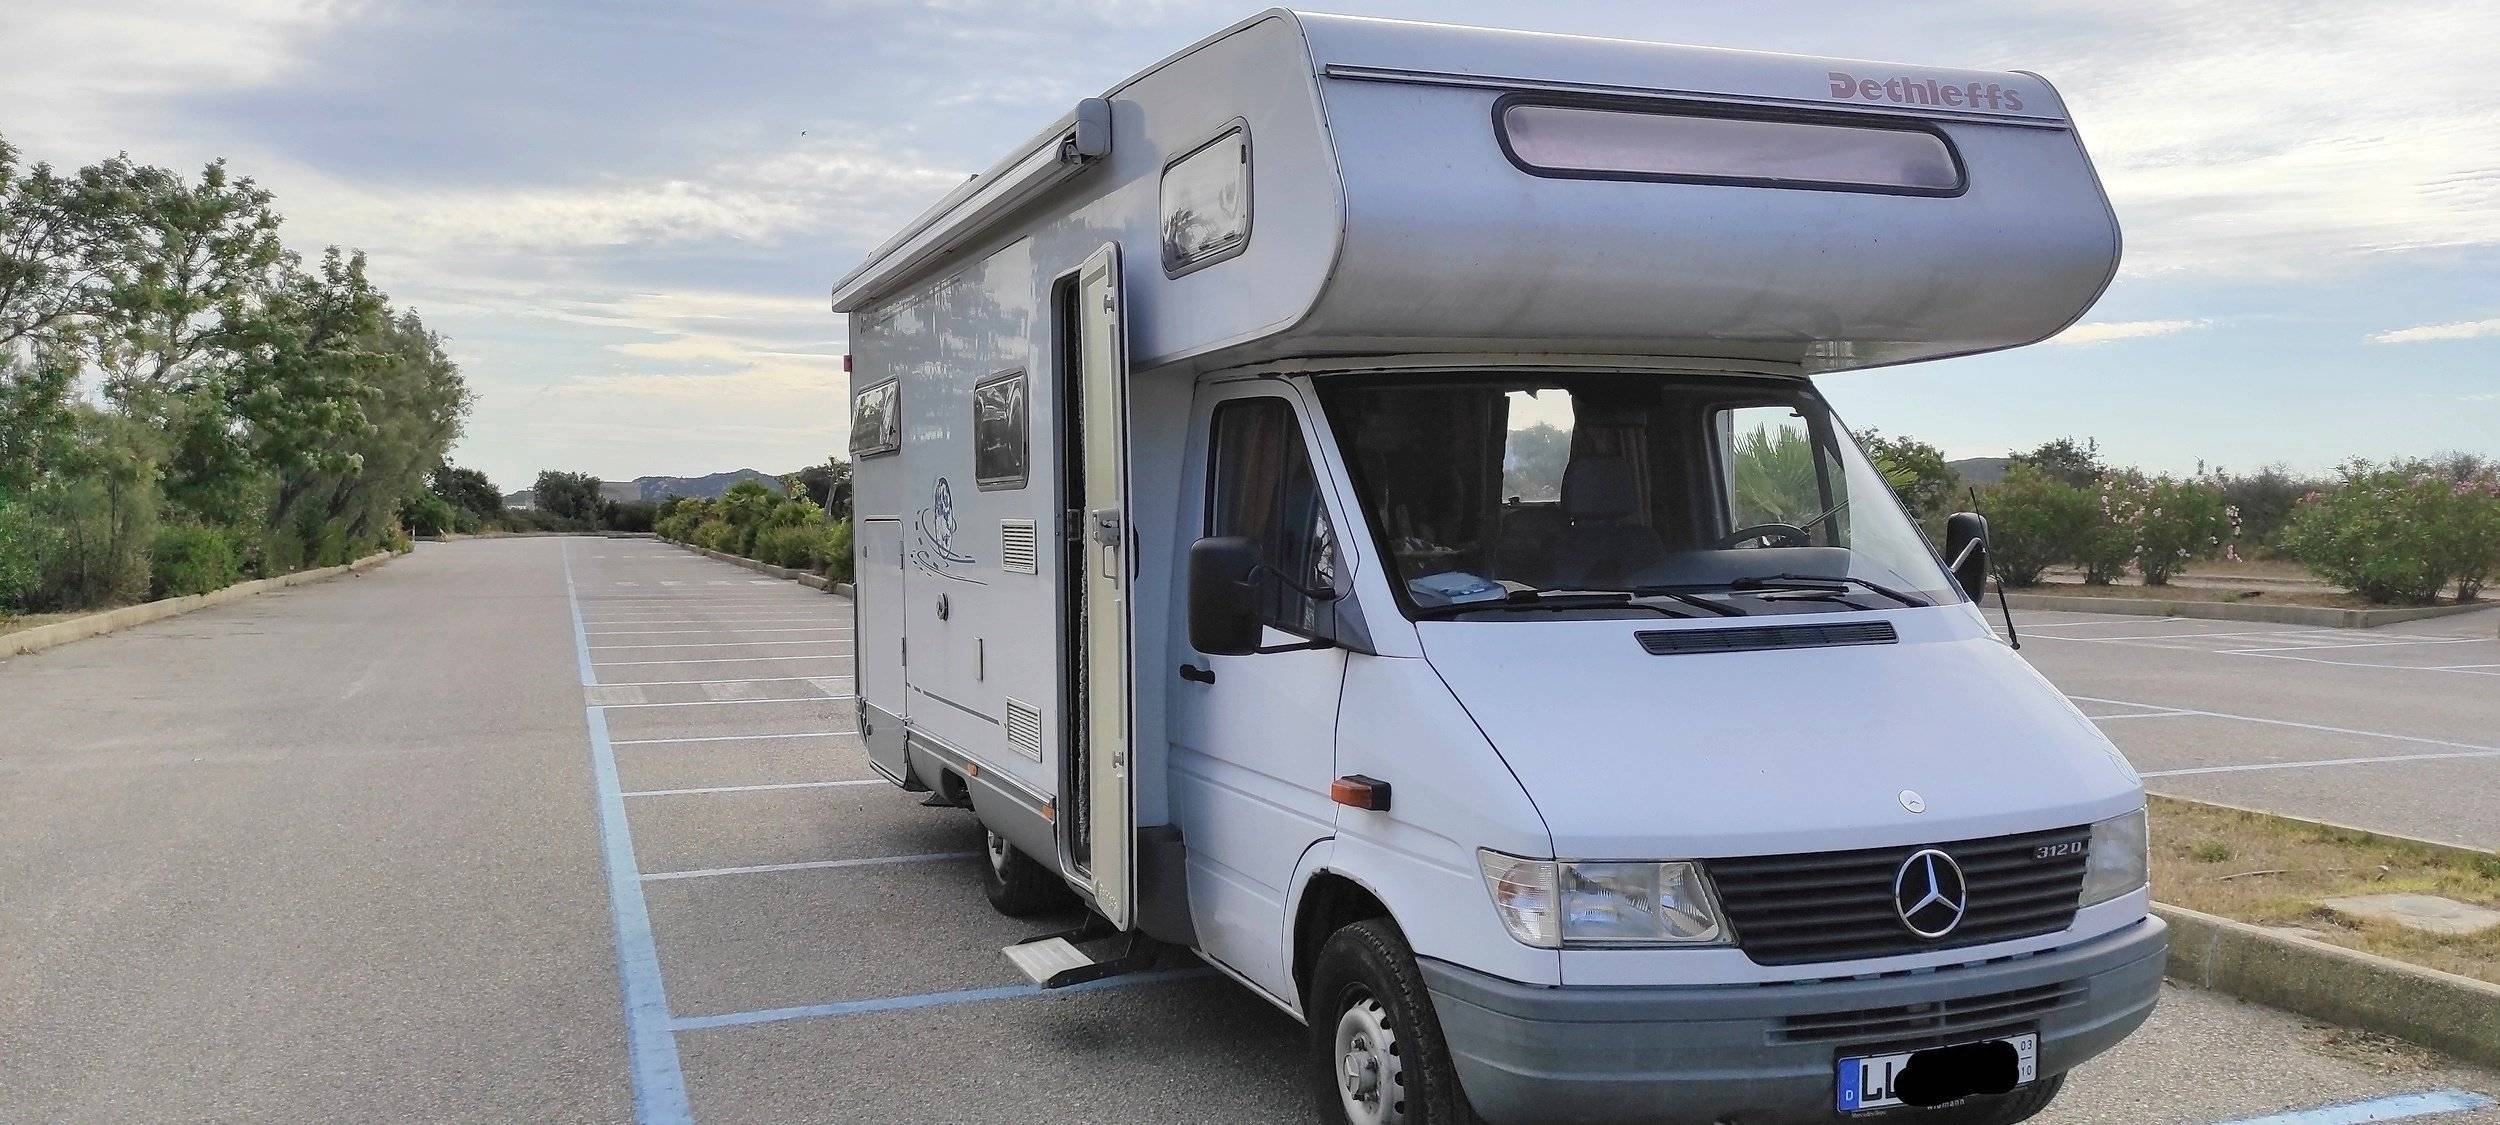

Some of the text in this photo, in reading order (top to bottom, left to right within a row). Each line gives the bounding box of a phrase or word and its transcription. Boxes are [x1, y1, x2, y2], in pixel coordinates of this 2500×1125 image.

[1828, 72, 2023, 112] Dethleffs
[2020, 1040, 2033, 1051] 03
[2021, 1065, 2032, 1076] 10
[1845, 1089, 1854, 1101] D
